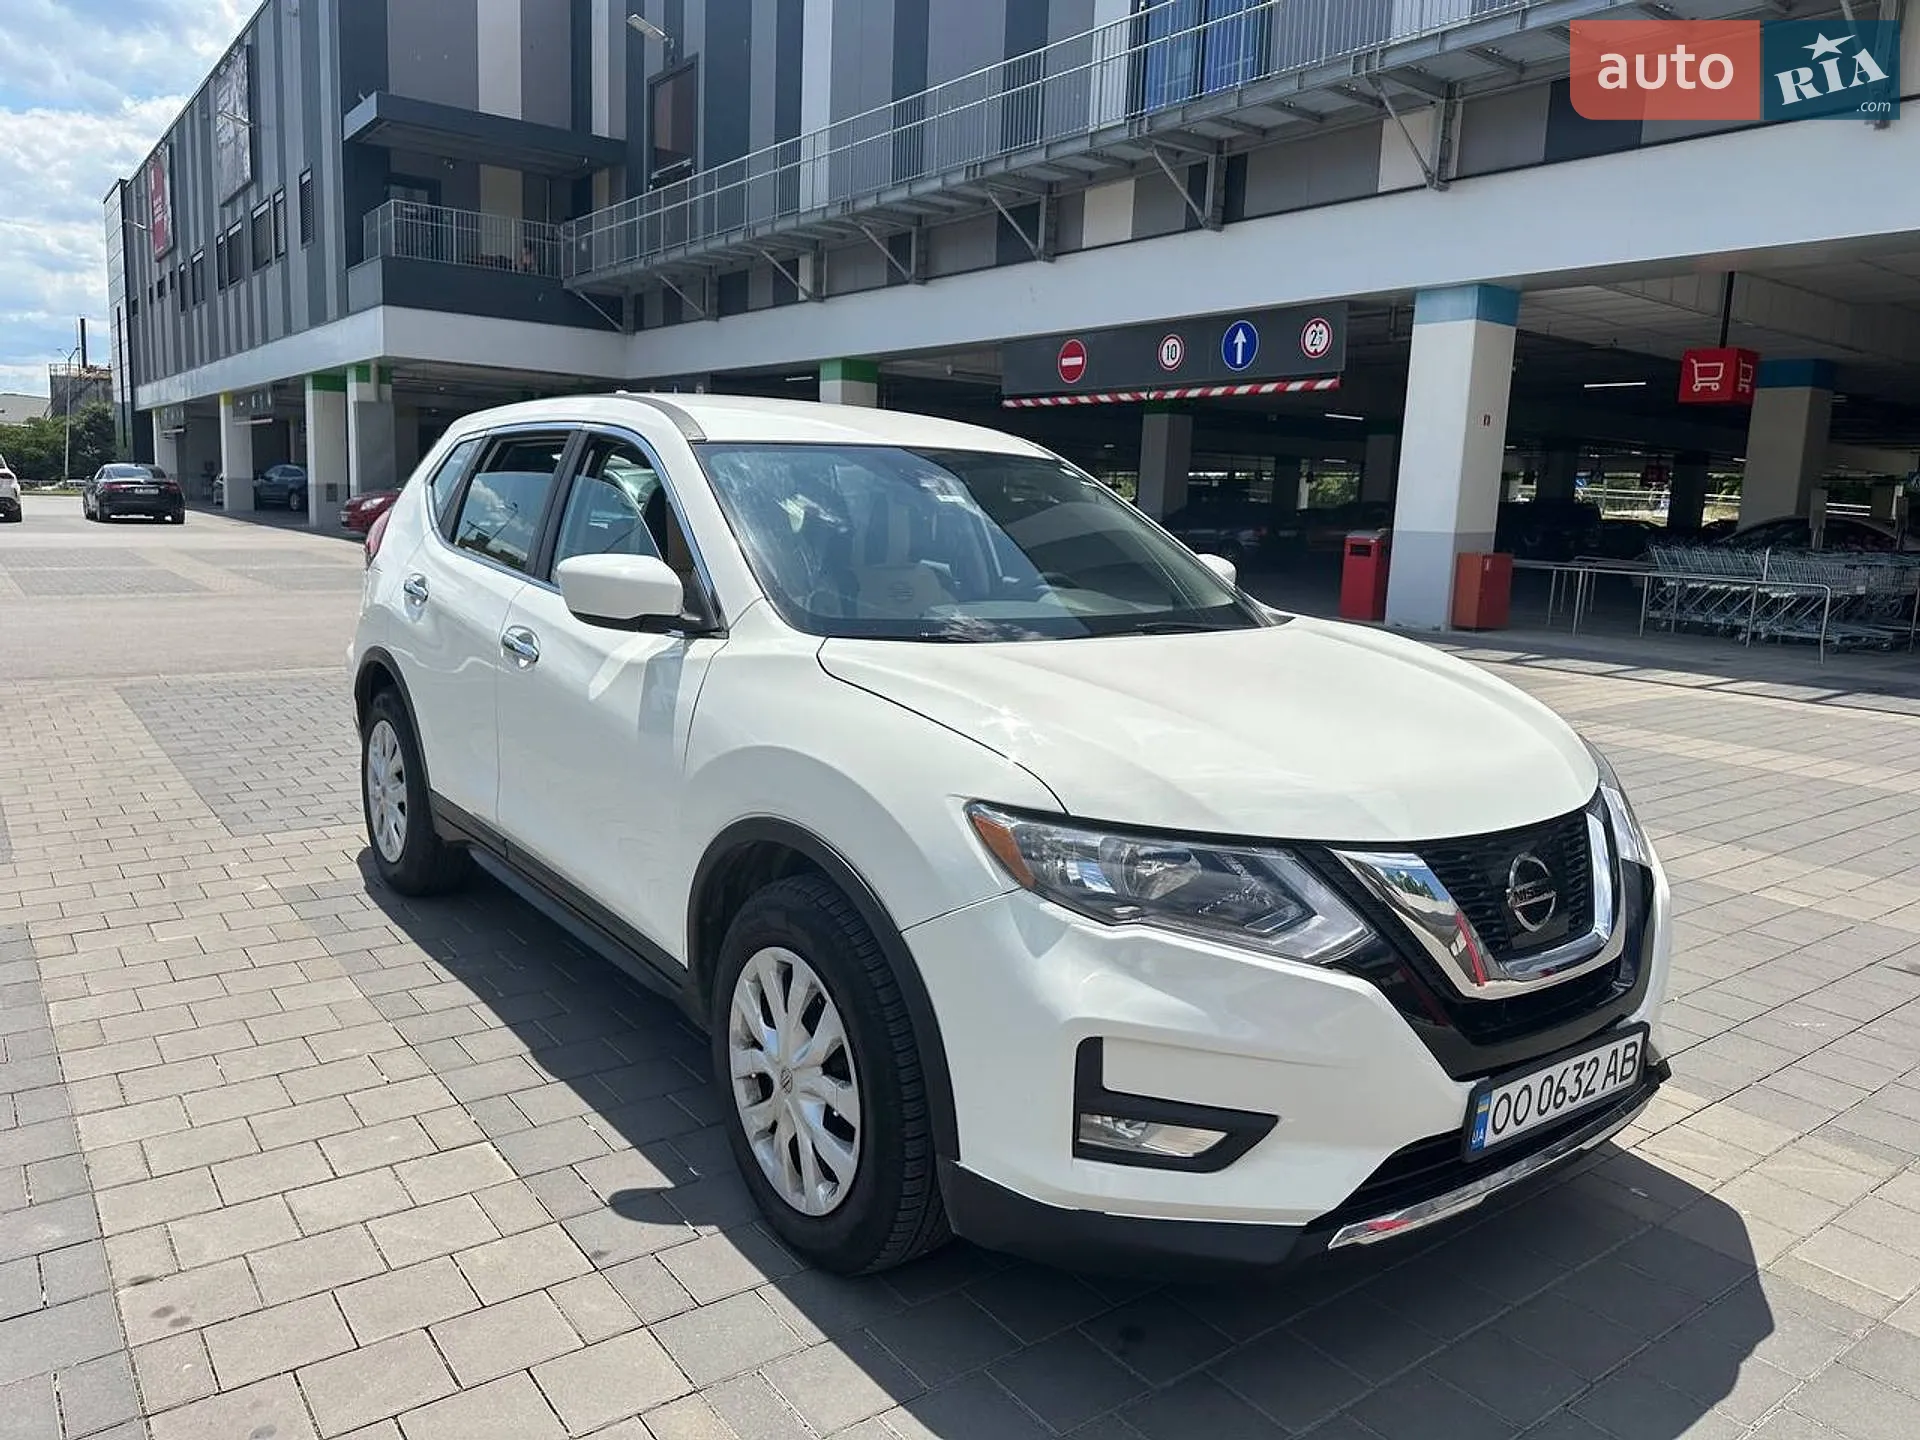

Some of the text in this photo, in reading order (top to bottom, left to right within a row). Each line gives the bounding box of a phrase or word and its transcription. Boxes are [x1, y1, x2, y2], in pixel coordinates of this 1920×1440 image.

[1166, 343, 1177, 361] 10
[1492, 1041, 1638, 1135] OO 0632 AB
